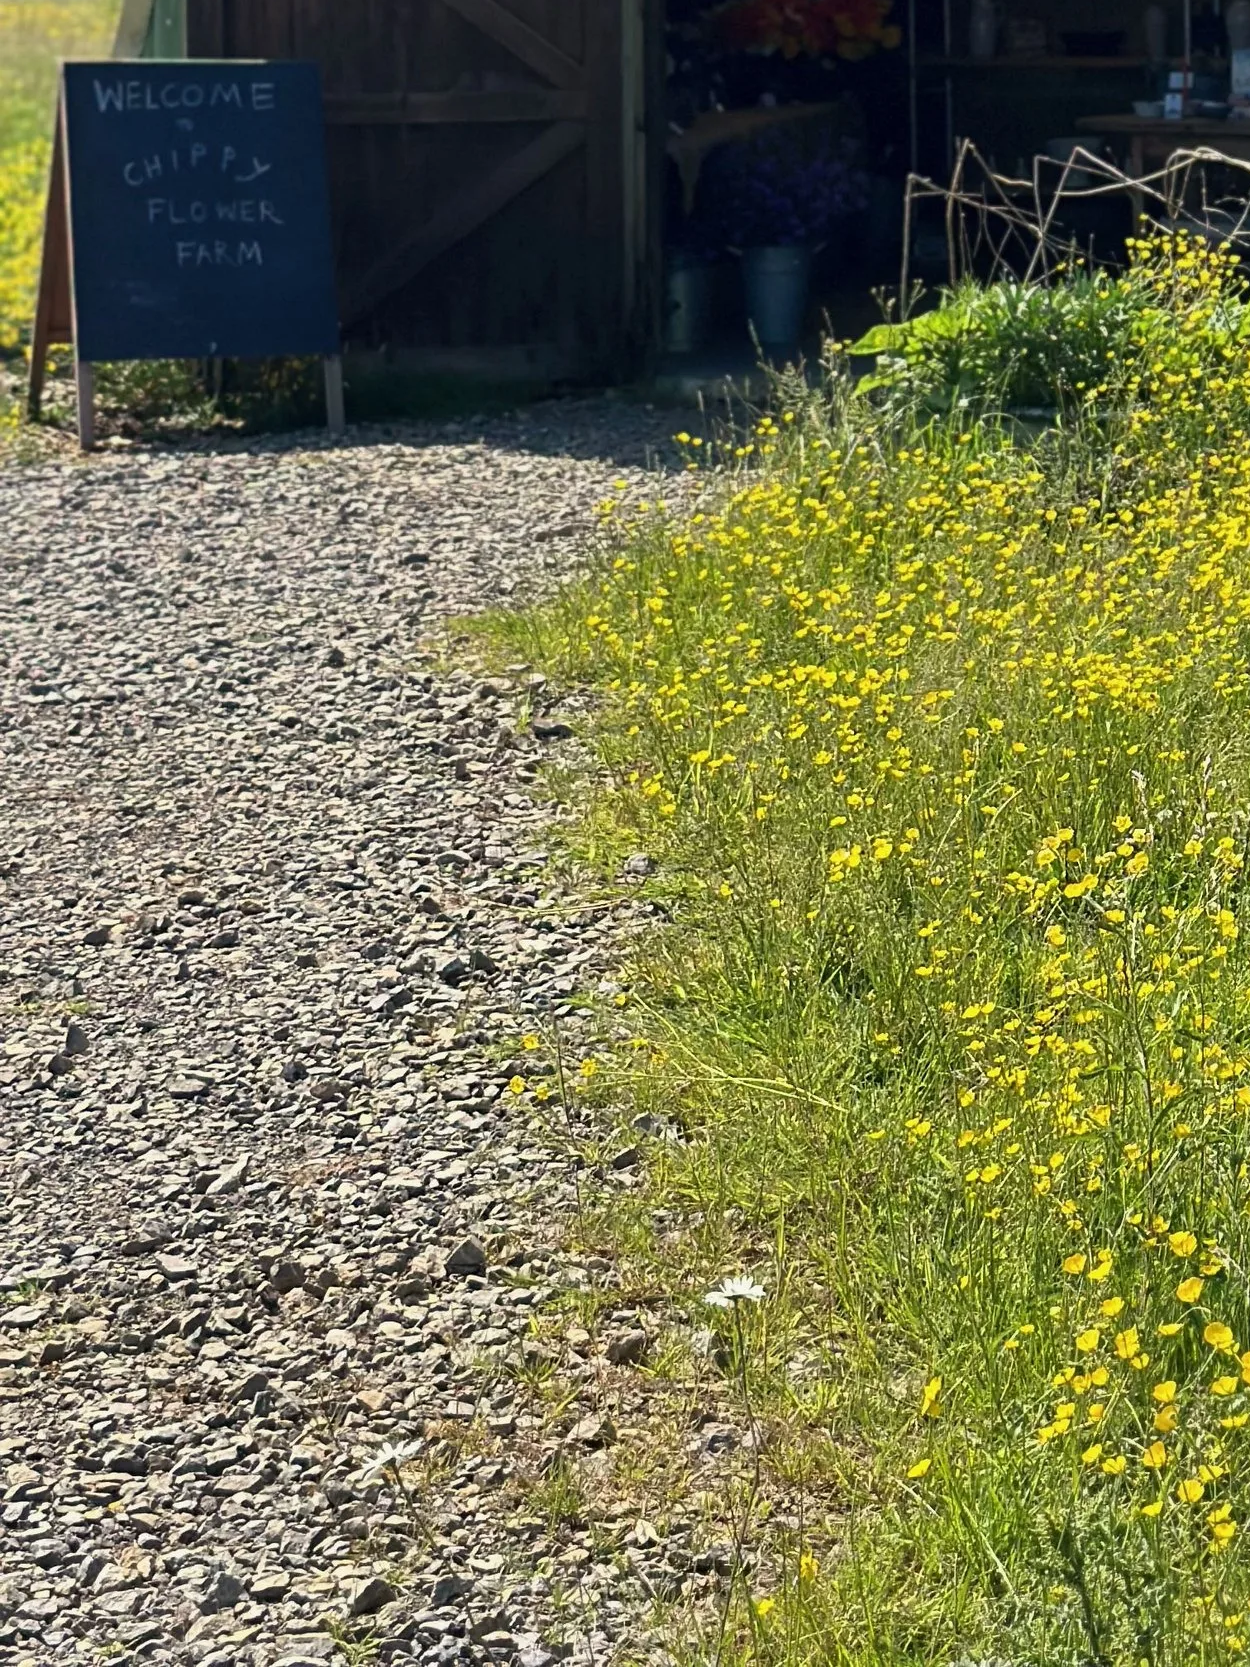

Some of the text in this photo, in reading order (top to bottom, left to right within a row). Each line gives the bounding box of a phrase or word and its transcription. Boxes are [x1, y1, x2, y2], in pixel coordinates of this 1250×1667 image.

[93, 79, 276, 113] WELCOME
[123, 142, 272, 187] CHIPPY
[147, 197, 285, 226] FLOWER
[175, 239, 263, 268] FARM
